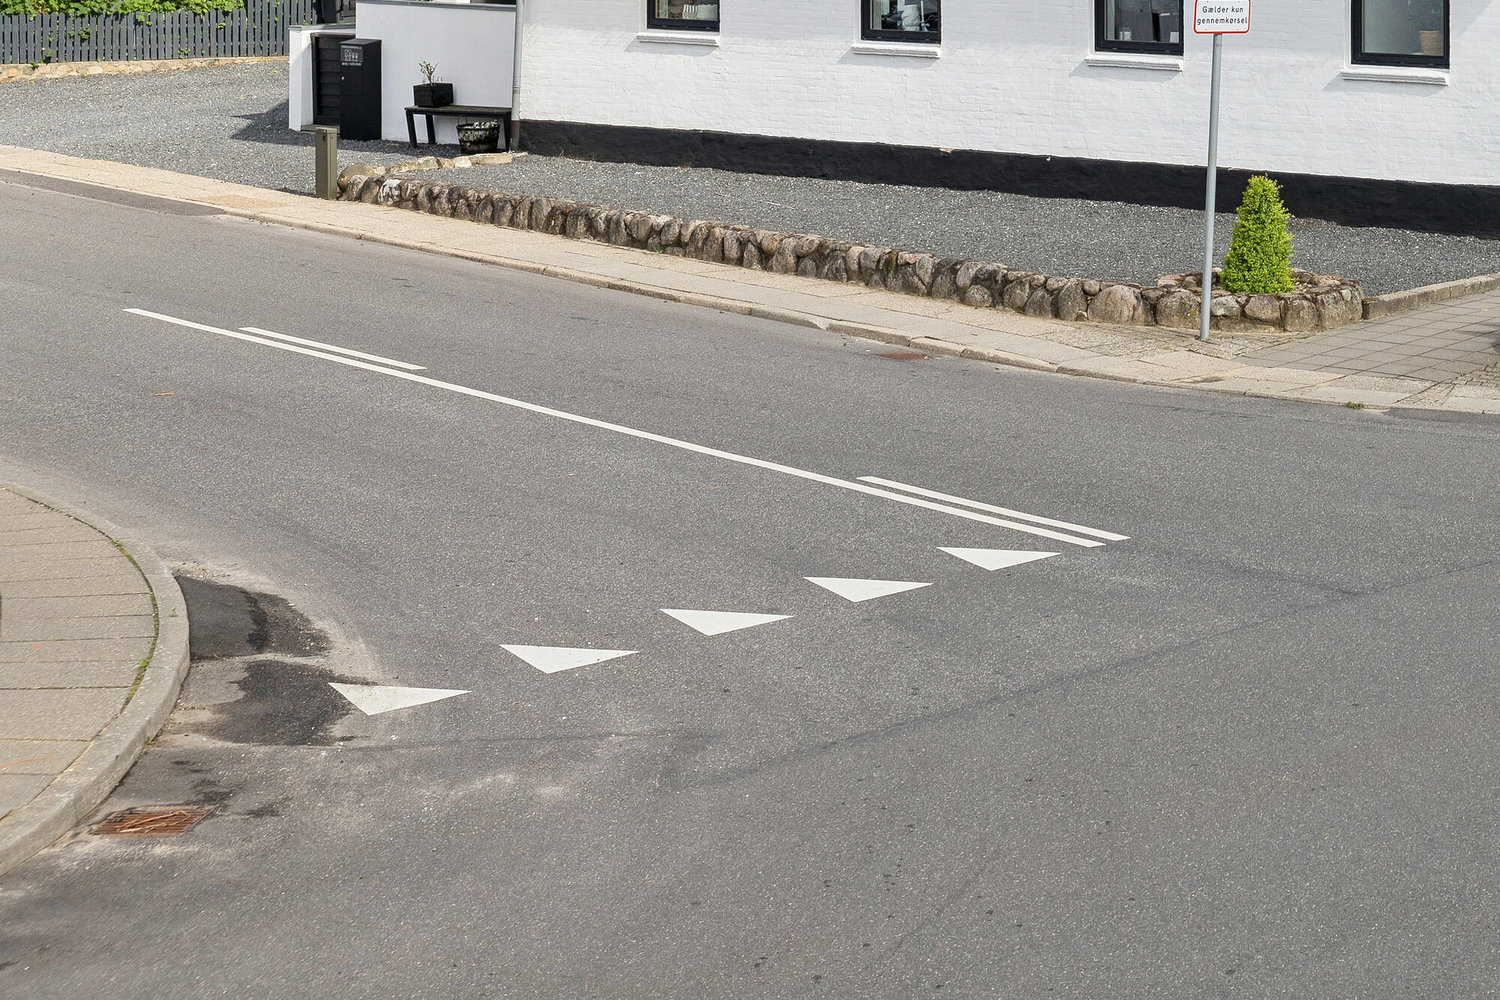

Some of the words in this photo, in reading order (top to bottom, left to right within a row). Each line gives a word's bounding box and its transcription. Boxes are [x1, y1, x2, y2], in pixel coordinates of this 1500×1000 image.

[1202, 5, 1229, 13] Gælder
[1231, 5, 1244, 13] kun
[1197, 16, 1248, 25] gennemkørsel
